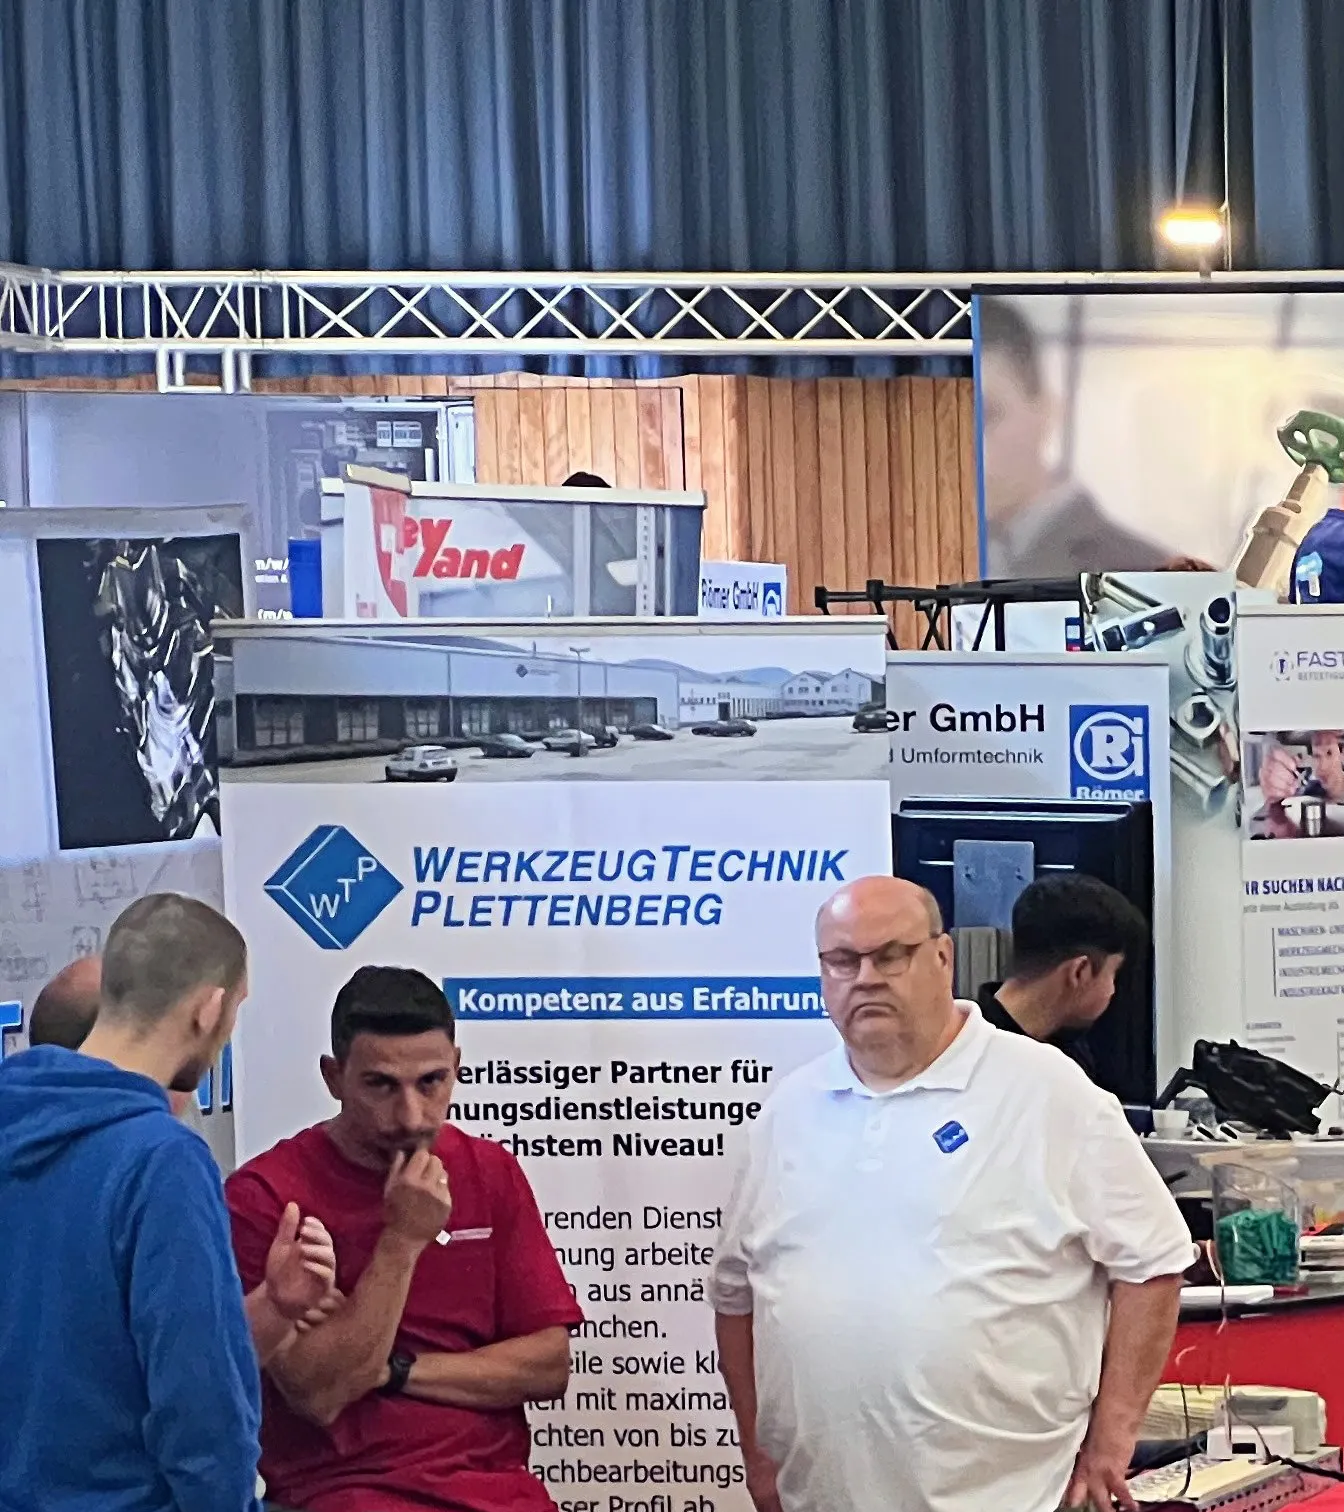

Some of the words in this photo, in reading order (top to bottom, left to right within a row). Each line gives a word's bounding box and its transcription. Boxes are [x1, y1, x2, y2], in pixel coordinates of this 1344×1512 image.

[929, 702, 1045, 733] GmbH
[901, 747, 1044, 765] Umformtechnik
[1245, 880, 1259, 896] IR
[1263, 878, 1314, 895] SUCHEN
[411, 890, 725, 927] PLETTENBERG
[458, 986, 623, 1017] Kompetenz
[631, 992, 684, 1012] aus
[457, 1059, 601, 1090] erlässiger
[611, 1060, 722, 1084] Partner
[730, 1059, 773, 1084] für
[613, 1133, 725, 1158] Niveau!
[544, 1205, 632, 1230] renden
[643, 1205, 723, 1230] Dienst
[624, 1241, 715, 1267] arbeite
[587, 1283, 632, 1302] aus
[640, 1278, 704, 1303] annä
[569, 1351, 603, 1375] ile
[612, 1350, 685, 1375] sowie
[695, 1350, 719, 1374] kl
[576, 1387, 617, 1411] mit
[626, 1387, 734, 1412] maxima
[529, 1423, 605, 1448] chten
[613, 1429, 660, 1448] von
[670, 1423, 707, 1448] bis
[532, 1459, 744, 1488] achbearbeitungs
